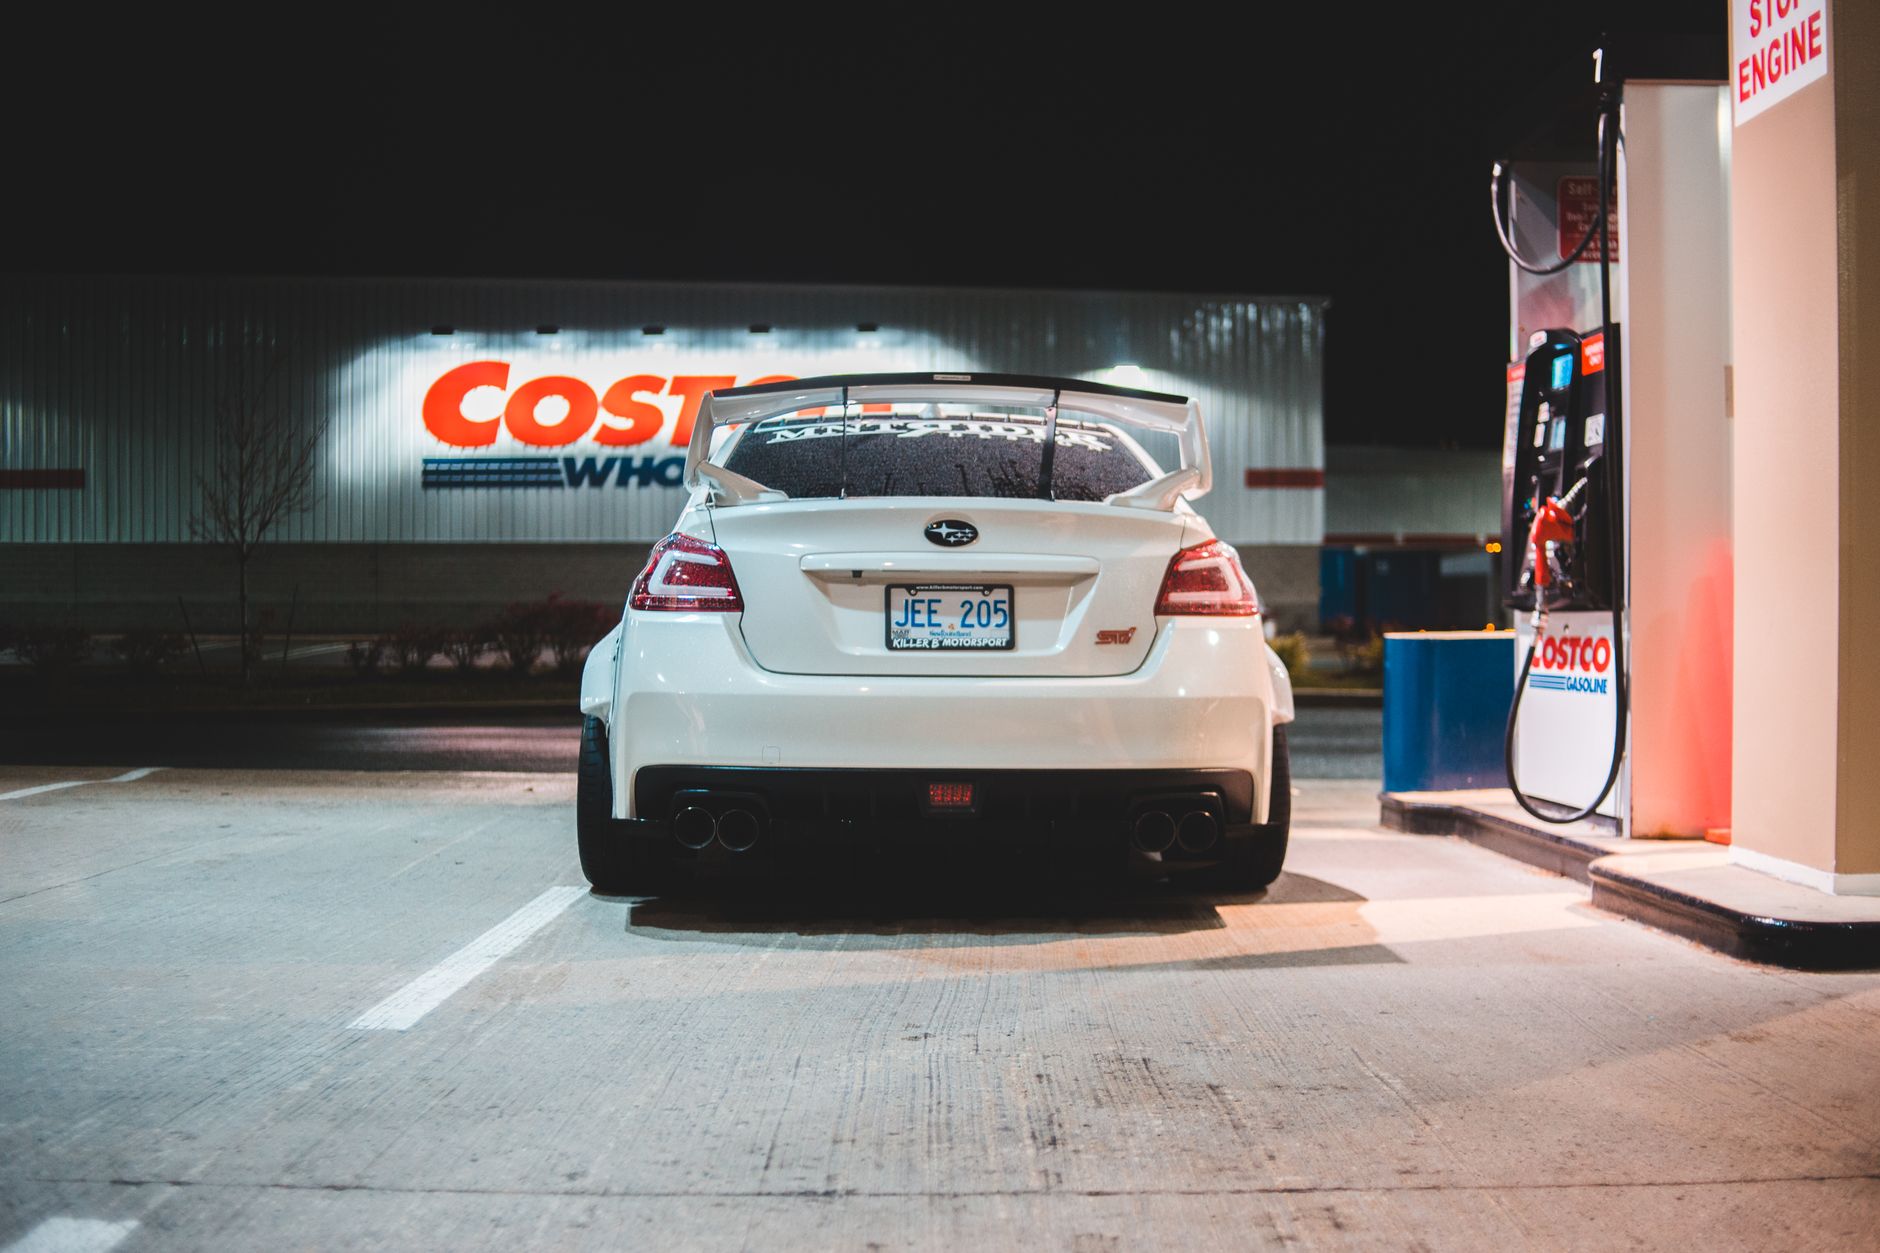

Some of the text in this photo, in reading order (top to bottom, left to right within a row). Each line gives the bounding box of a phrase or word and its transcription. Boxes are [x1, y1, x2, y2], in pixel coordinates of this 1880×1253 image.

[1750, 0, 1799, 38] ST
[1592, 48, 1603, 83] 1
[1739, 10, 1822, 103] ENGINE
[422, 360, 803, 448] COST
[895, 599, 1008, 629] JEE 205
[893, 638, 1007, 648] KILLER B MOTORSPORT
[1567, 676, 1608, 695] GASOLINE
